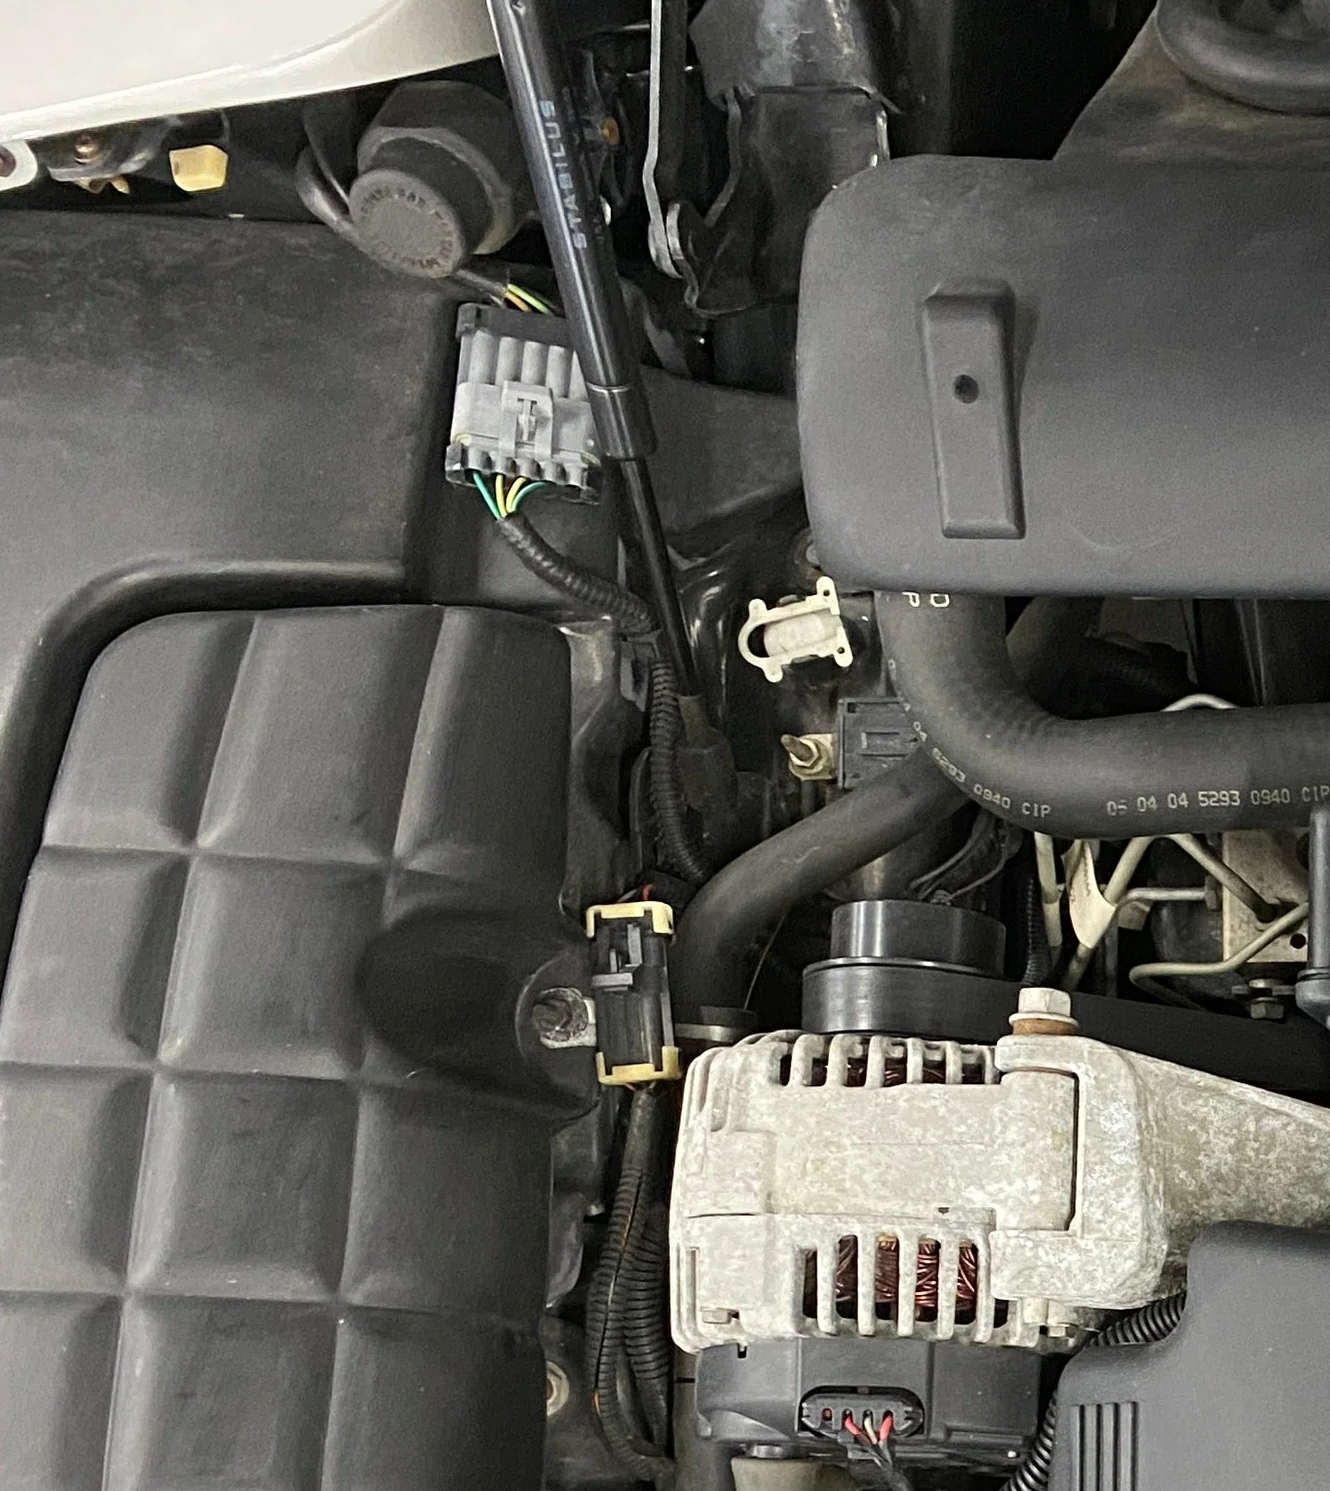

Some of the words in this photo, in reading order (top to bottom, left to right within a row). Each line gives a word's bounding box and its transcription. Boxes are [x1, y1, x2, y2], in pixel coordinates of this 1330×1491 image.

[538, 97, 589, 251] STABILUS
[1022, 802, 1051, 818] CIP
[1136, 795, 1157, 812] 04
[1167, 791, 1189, 809] 04
[1197, 790, 1240, 807] 5293
[1250, 787, 1290, 805] 0940
[1301, 785, 1330, 802] CIP
